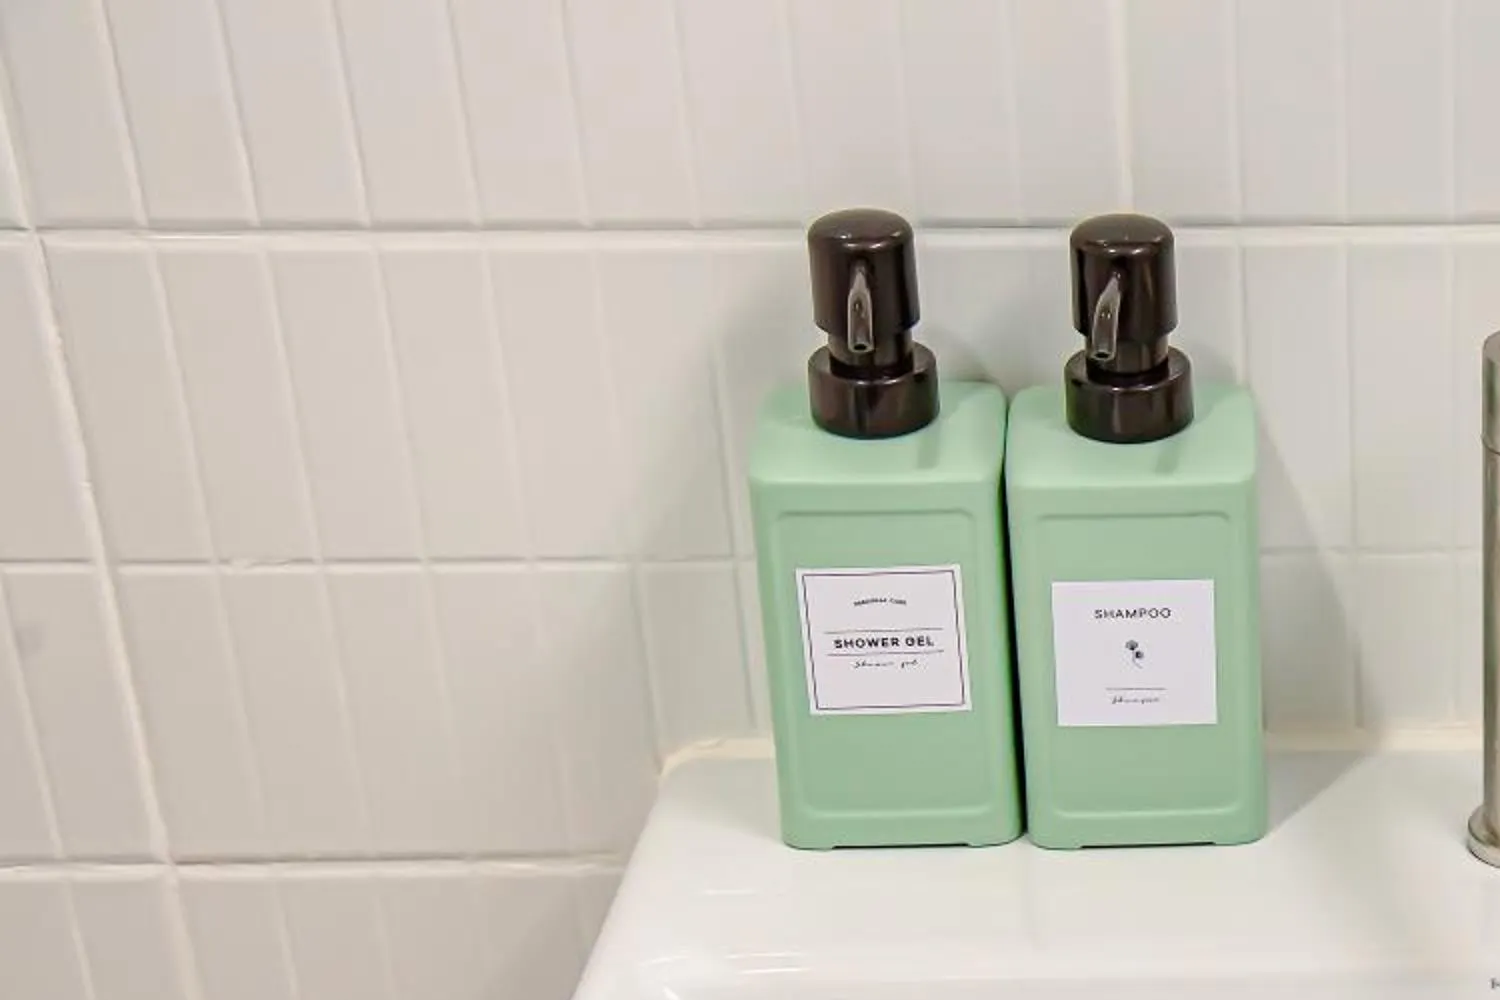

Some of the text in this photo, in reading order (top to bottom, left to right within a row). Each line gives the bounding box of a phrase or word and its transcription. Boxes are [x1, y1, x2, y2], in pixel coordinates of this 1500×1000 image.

[1094, 607, 1171, 619] SHAMPOO
[833, 635, 934, 649] SHOWER GEL
